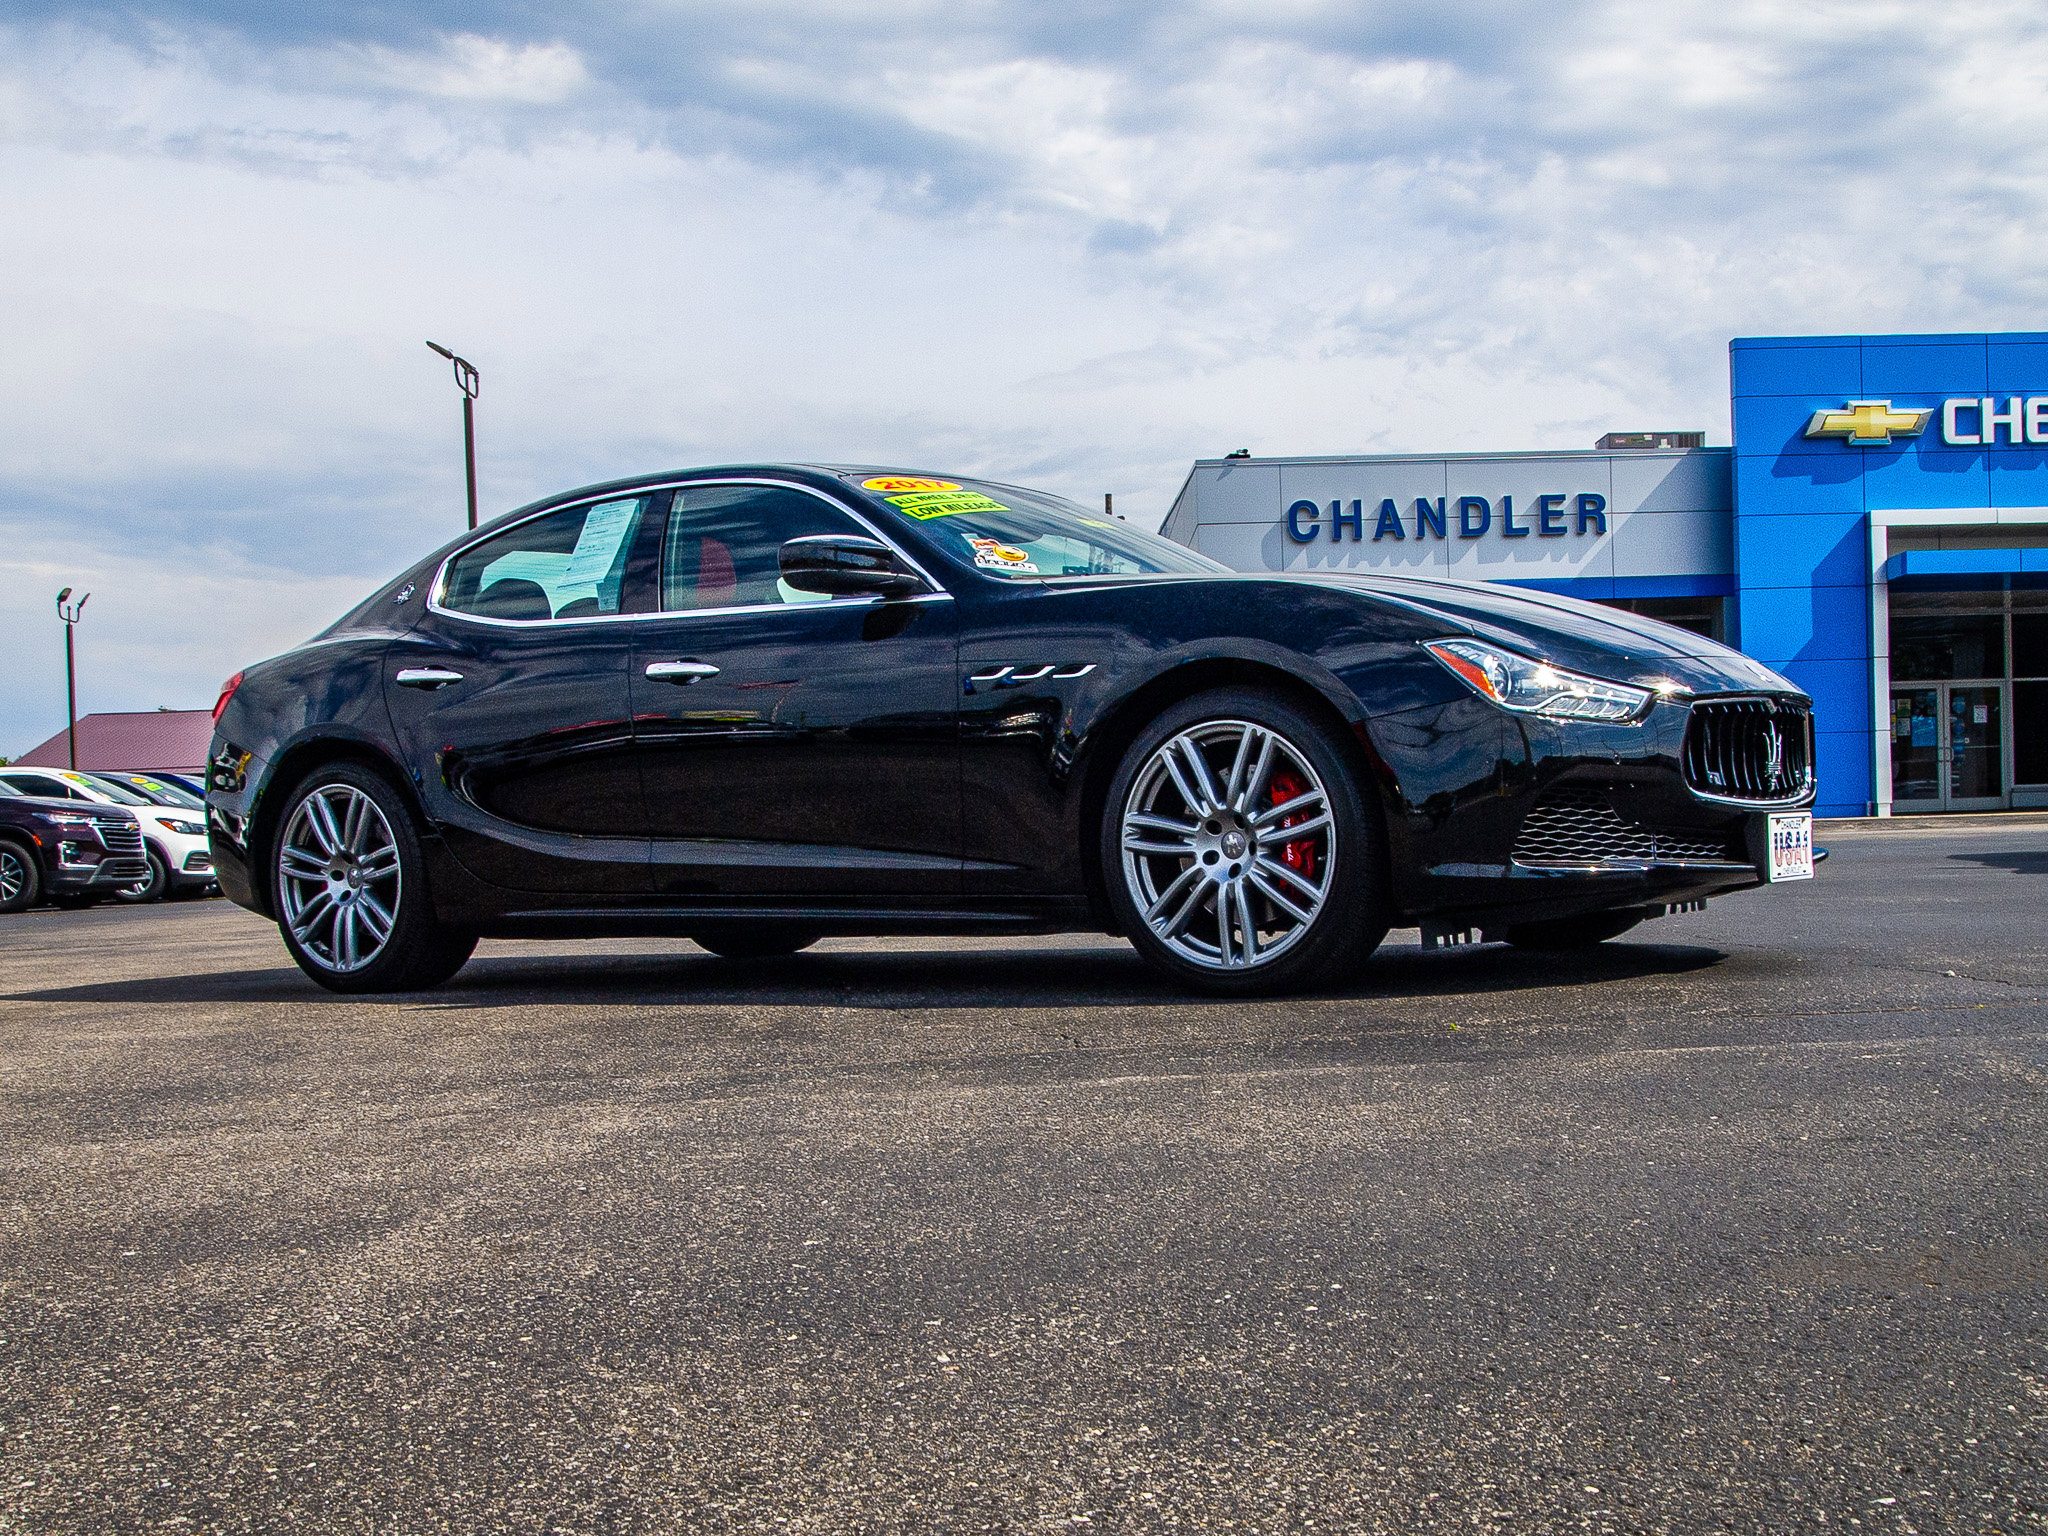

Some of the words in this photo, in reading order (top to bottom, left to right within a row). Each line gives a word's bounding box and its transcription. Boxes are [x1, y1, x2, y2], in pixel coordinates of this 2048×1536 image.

[876, 480, 944, 490] 2017
[895, 496, 915, 505] ALL
[909, 506, 945, 517] LOW
[944, 502, 1000, 511] MILEAGE
[1287, 492, 1608, 543] CHANDLER
